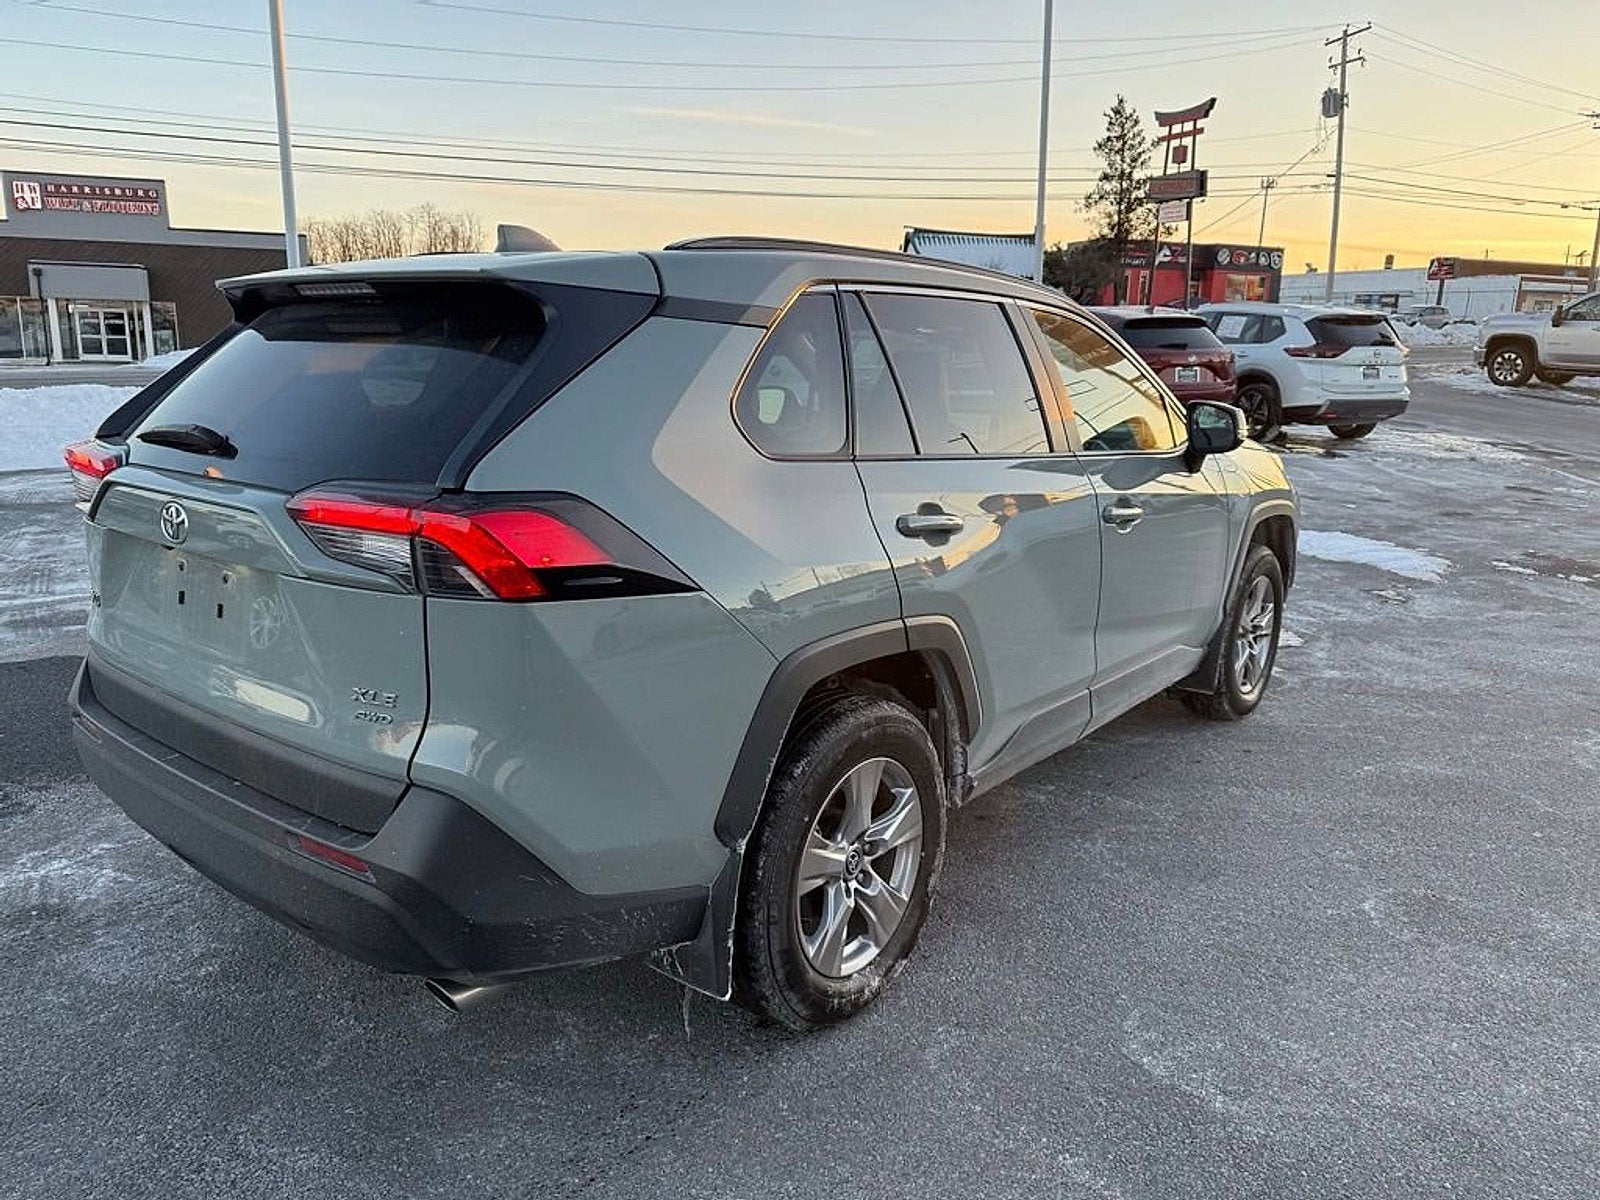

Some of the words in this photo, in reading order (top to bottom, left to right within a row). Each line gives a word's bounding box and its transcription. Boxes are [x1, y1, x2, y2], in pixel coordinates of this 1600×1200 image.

[46, 184, 158, 198] HARRISBURG
[44, 197, 80, 210] WALL
[350, 687, 398, 708] XLE
